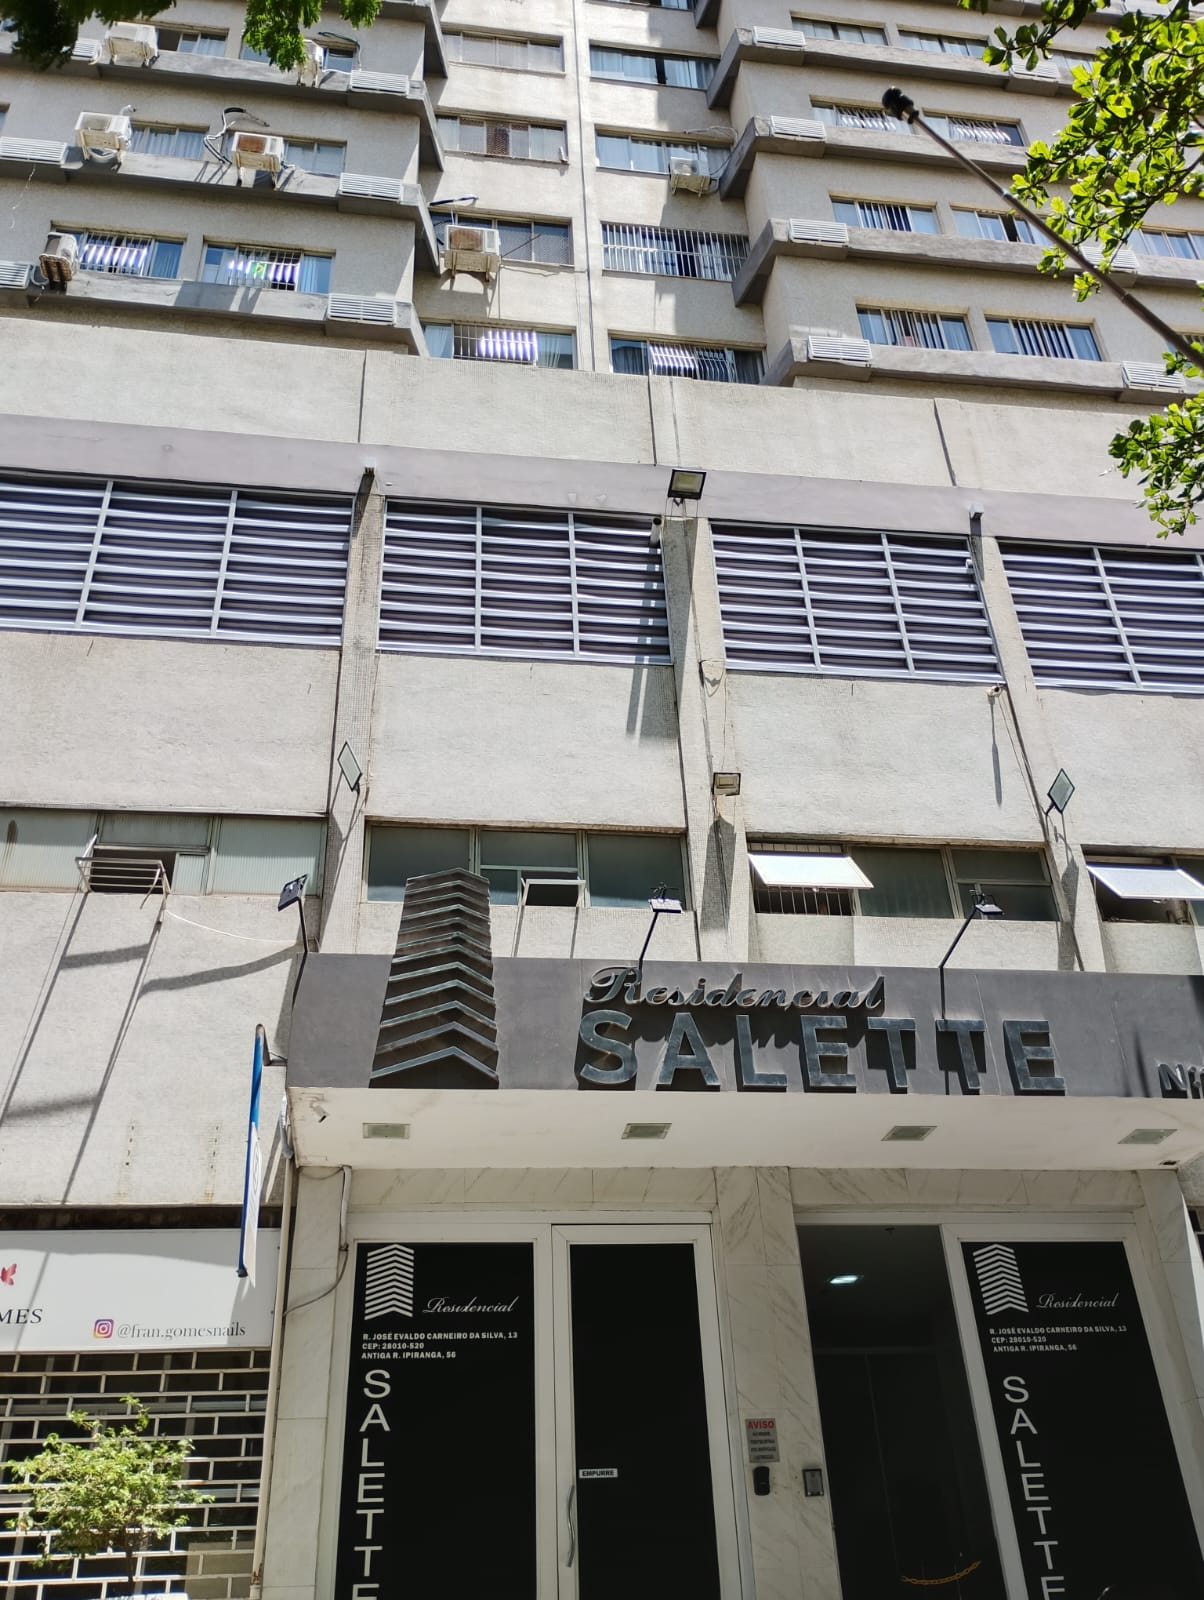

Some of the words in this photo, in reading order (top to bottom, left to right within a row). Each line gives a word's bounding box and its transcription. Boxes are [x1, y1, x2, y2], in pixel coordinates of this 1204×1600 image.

[584, 966, 885, 1010] Residencial
[578, 1010, 1066, 1092] SALETTE
[422, 1296, 519, 1313] Residencial
[1035, 1292, 1120, 1309] Residencial
[117, 1321, 246, 1340] @fran.gomesnails
[393, 1332, 426, 1340] EVALDO
[426, 1332, 468, 1340] CARNEIRO
[469, 1332, 480, 1340] DA
[481, 1331, 507, 1340] SILVA,
[508, 1331, 518, 1339] 13
[1045, 1326, 1083, 1334] CARNEIRO
[361, 1342, 381, 1350] CEP:
[381, 1342, 425, 1350] 28010-520
[361, 1352, 391, 1360] ANTIGA
[402, 1351, 445, 1359] IPIRANGA,
[446, 1351, 457, 1359] 56
[747, 1420, 775, 1430] AVISO
